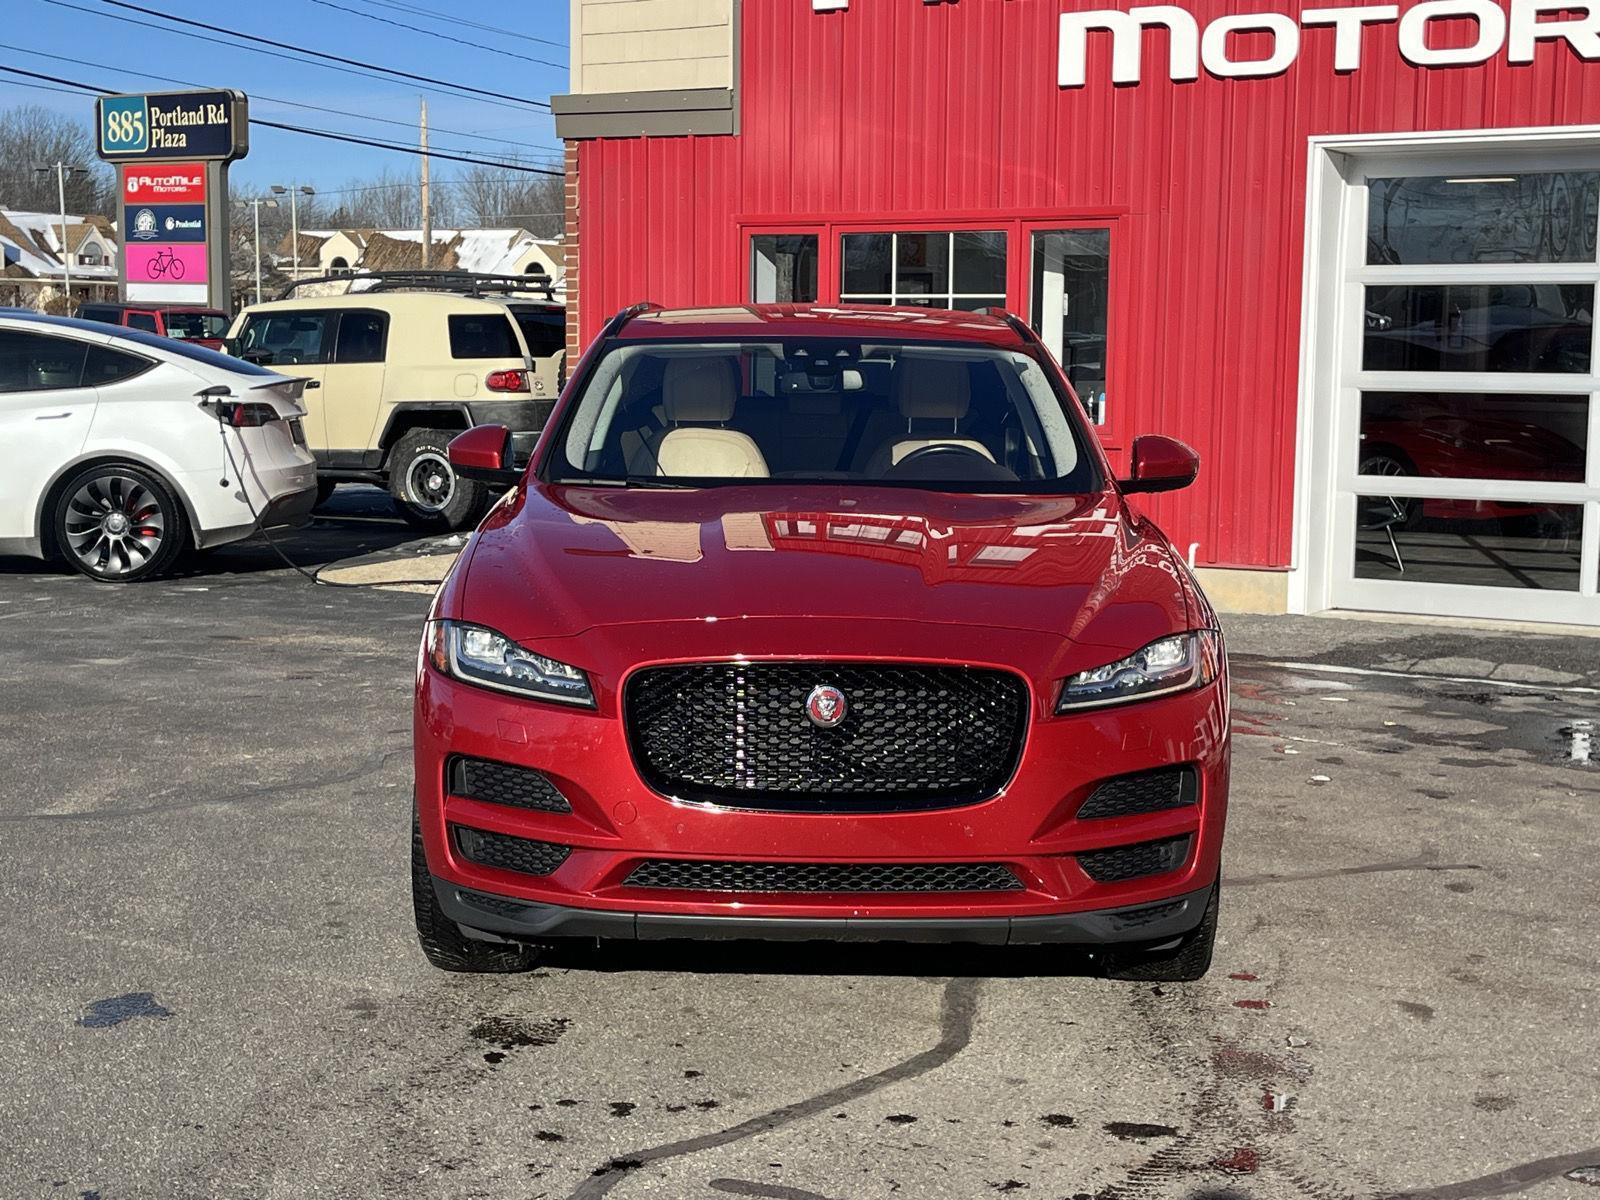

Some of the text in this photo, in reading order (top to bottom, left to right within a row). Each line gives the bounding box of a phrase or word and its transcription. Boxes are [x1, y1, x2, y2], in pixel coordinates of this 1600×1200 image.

[151, 104, 228, 127] Portland Rd.
[108, 111, 144, 145] 885
[152, 128, 186, 148] Plaza
[175, 220, 202, 228] Prudential
